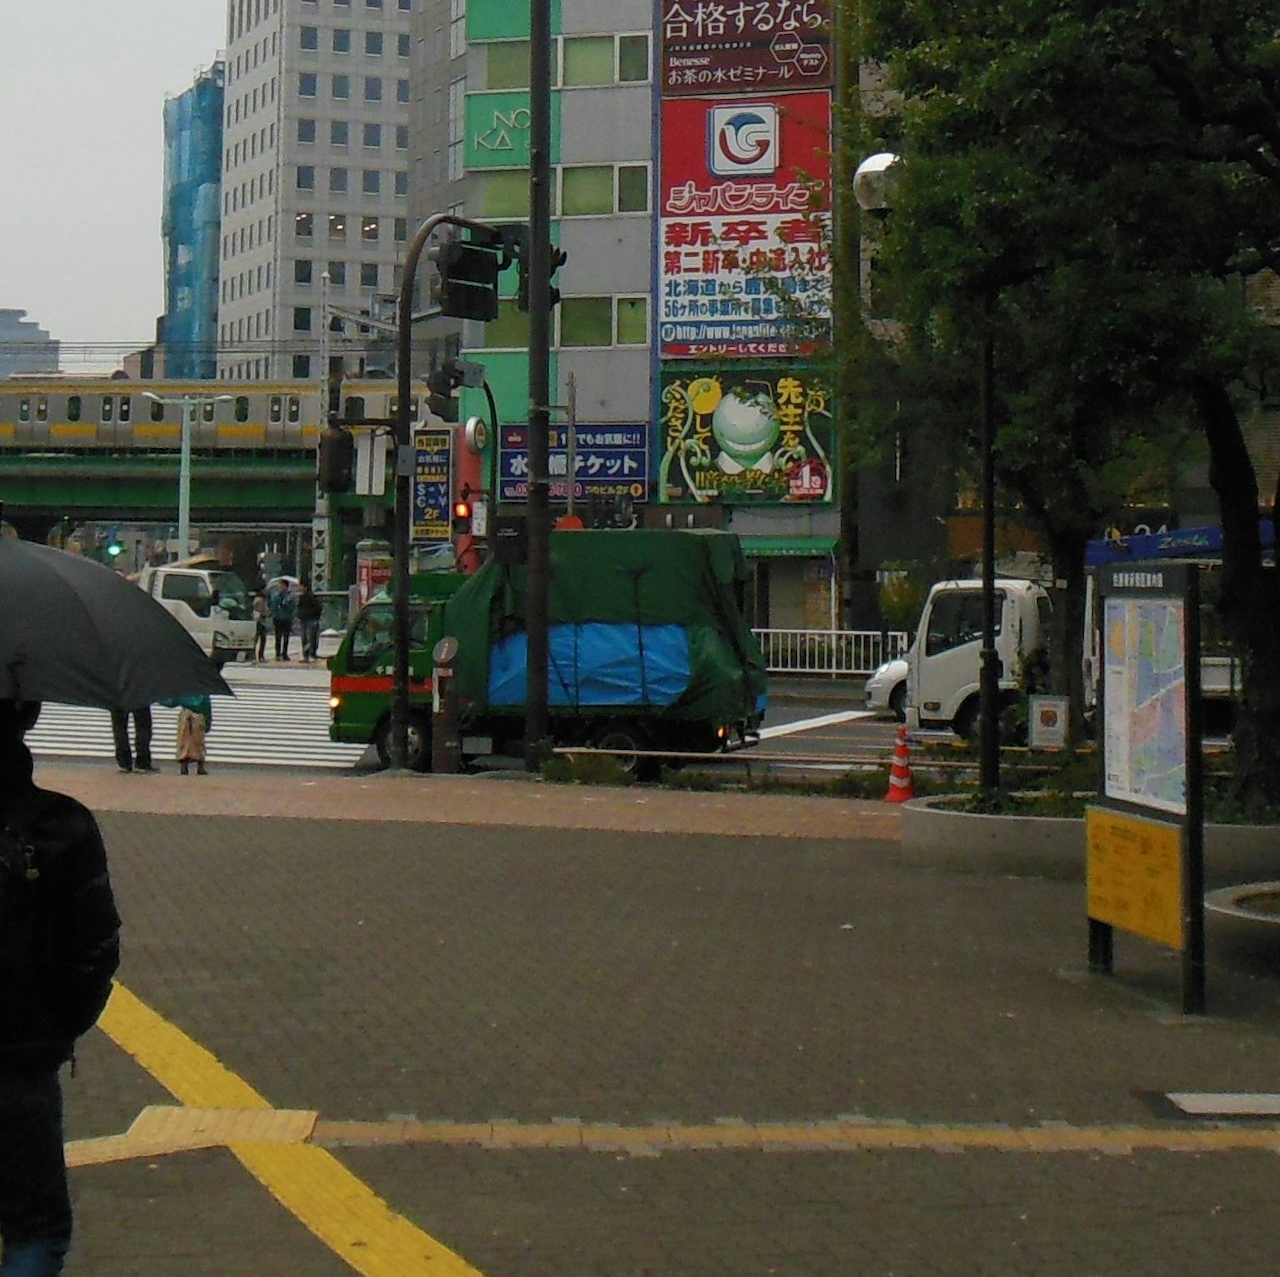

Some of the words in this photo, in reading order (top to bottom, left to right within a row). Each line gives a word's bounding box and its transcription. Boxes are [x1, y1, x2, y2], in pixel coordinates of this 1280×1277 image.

[669, 56, 711, 67] Benesse
[668, 65, 794, 85] お茶の水ゼミナール
[509, 453, 638, 476] 水橋チケット
